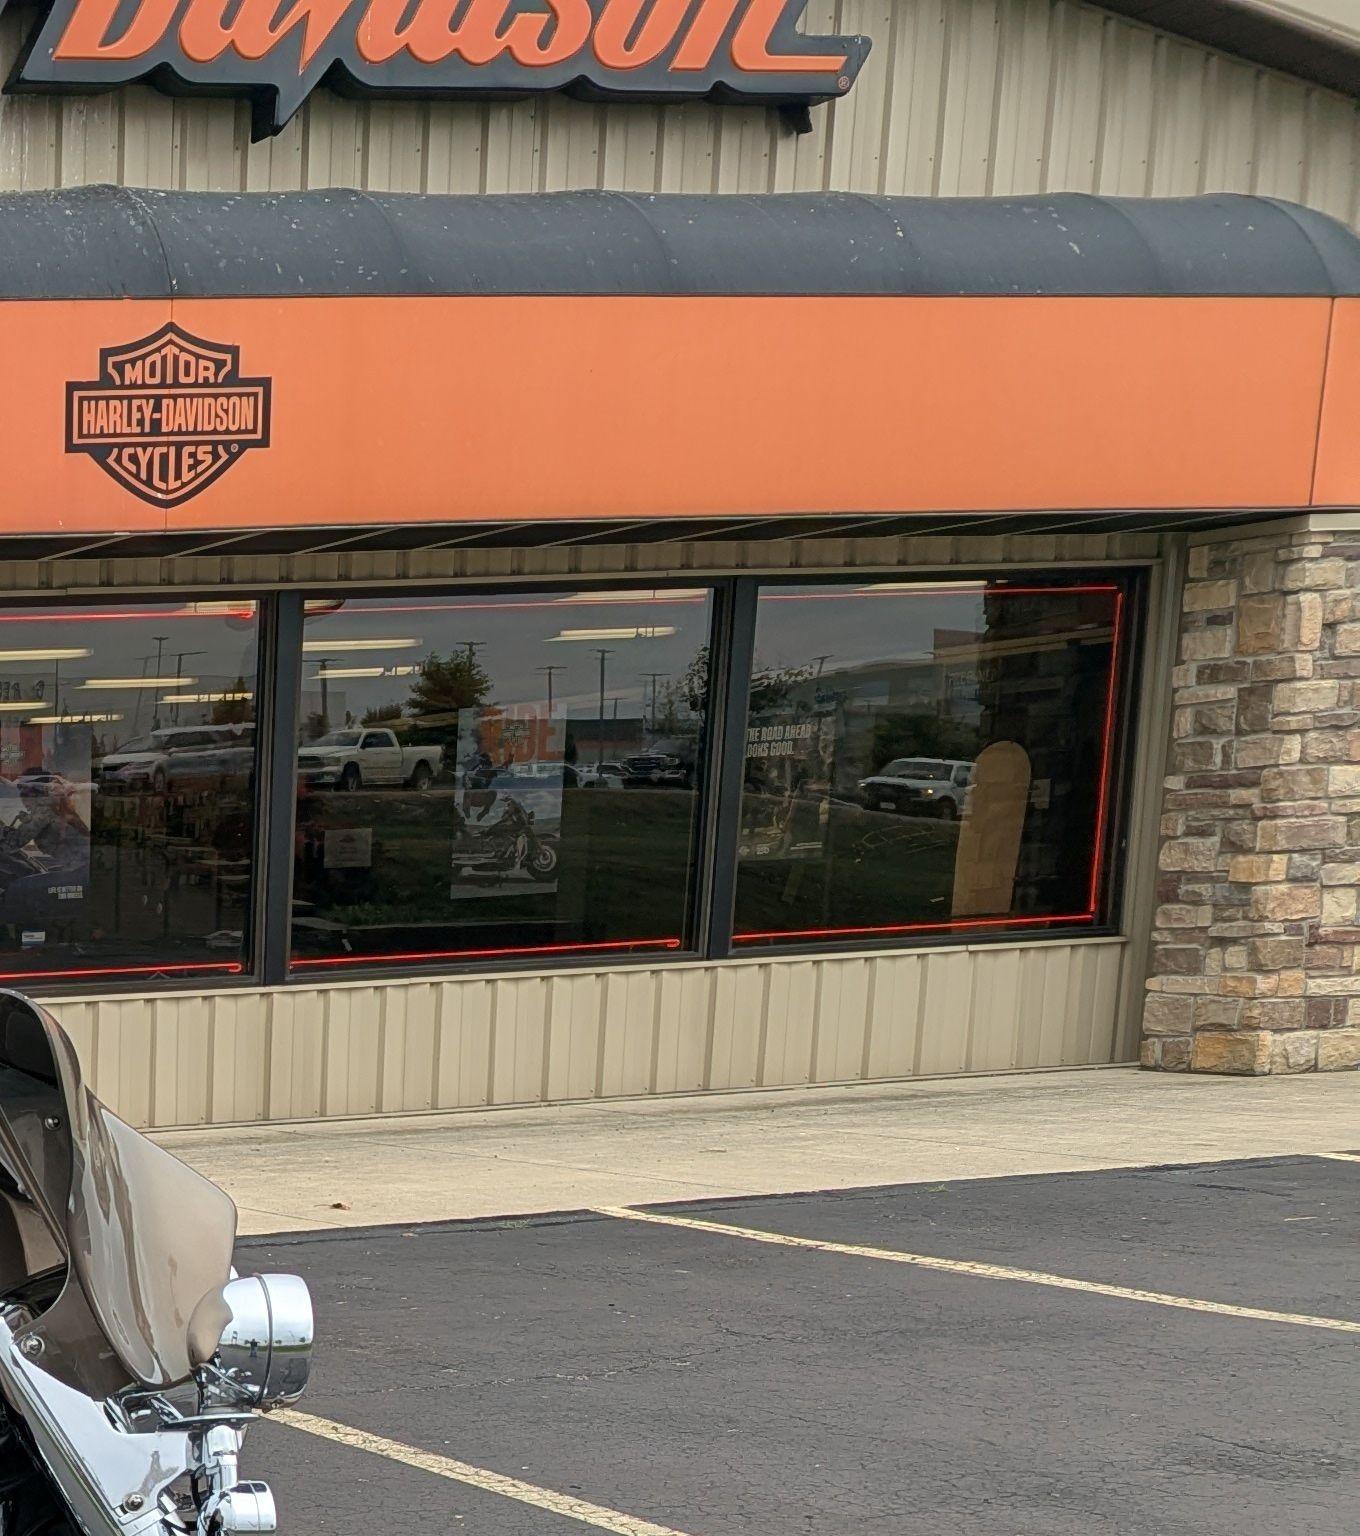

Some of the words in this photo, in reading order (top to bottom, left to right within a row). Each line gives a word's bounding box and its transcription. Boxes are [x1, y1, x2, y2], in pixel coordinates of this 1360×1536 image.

[124, 344, 216, 386] MOTOR
[82, 396, 255, 435] HARLEY-DAVIDSON
[121, 445, 213, 490] CYCLES
[746, 742, 769, 758] OOKS
[761, 726, 783, 741] ROAD
[784, 723, 811, 739] AHEAD
